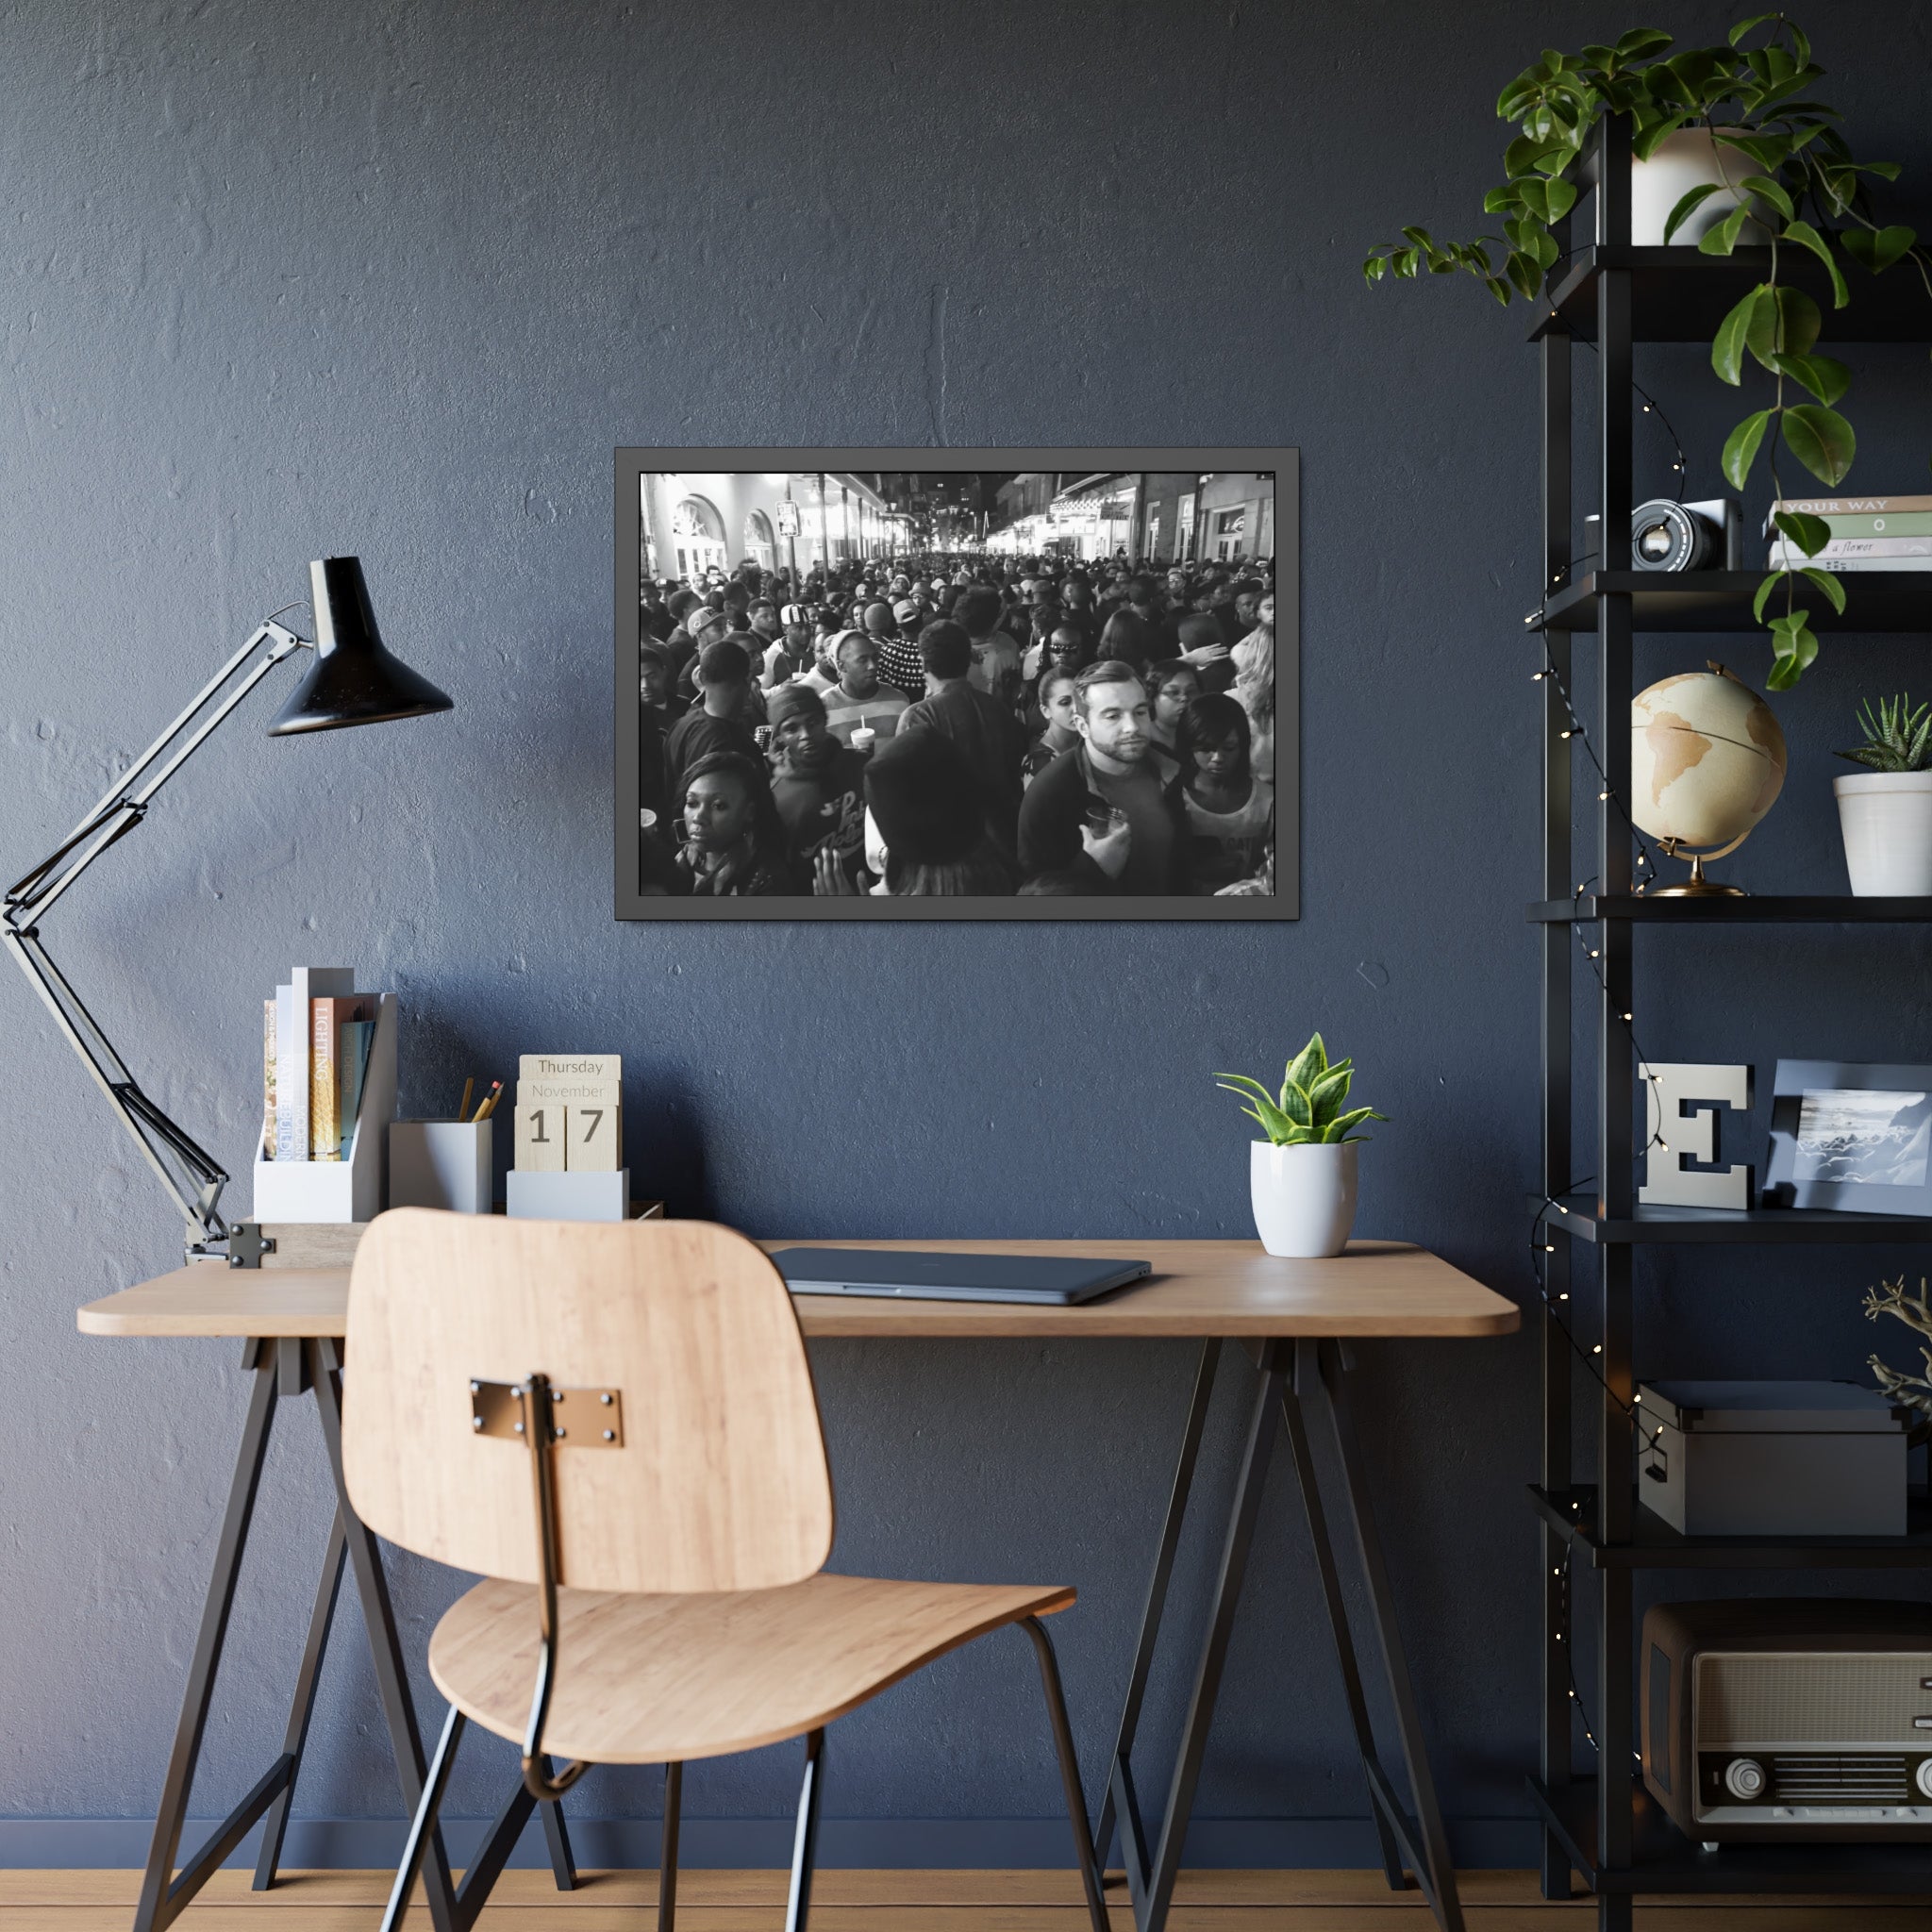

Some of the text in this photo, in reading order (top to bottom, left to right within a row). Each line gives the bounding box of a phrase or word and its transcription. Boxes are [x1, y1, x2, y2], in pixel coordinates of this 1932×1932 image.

[1786, 500, 1888, 512] YOUR WAY
[1841, 541, 1874, 556] flower
[314, 1007, 328, 1081] LIGHTING
[539, 1059, 605, 1074] Thursday
[344, 1056, 353, 1093] DESIGN
[532, 1085, 605, 1098] November
[294, 1105, 306, 1160] MODERN
